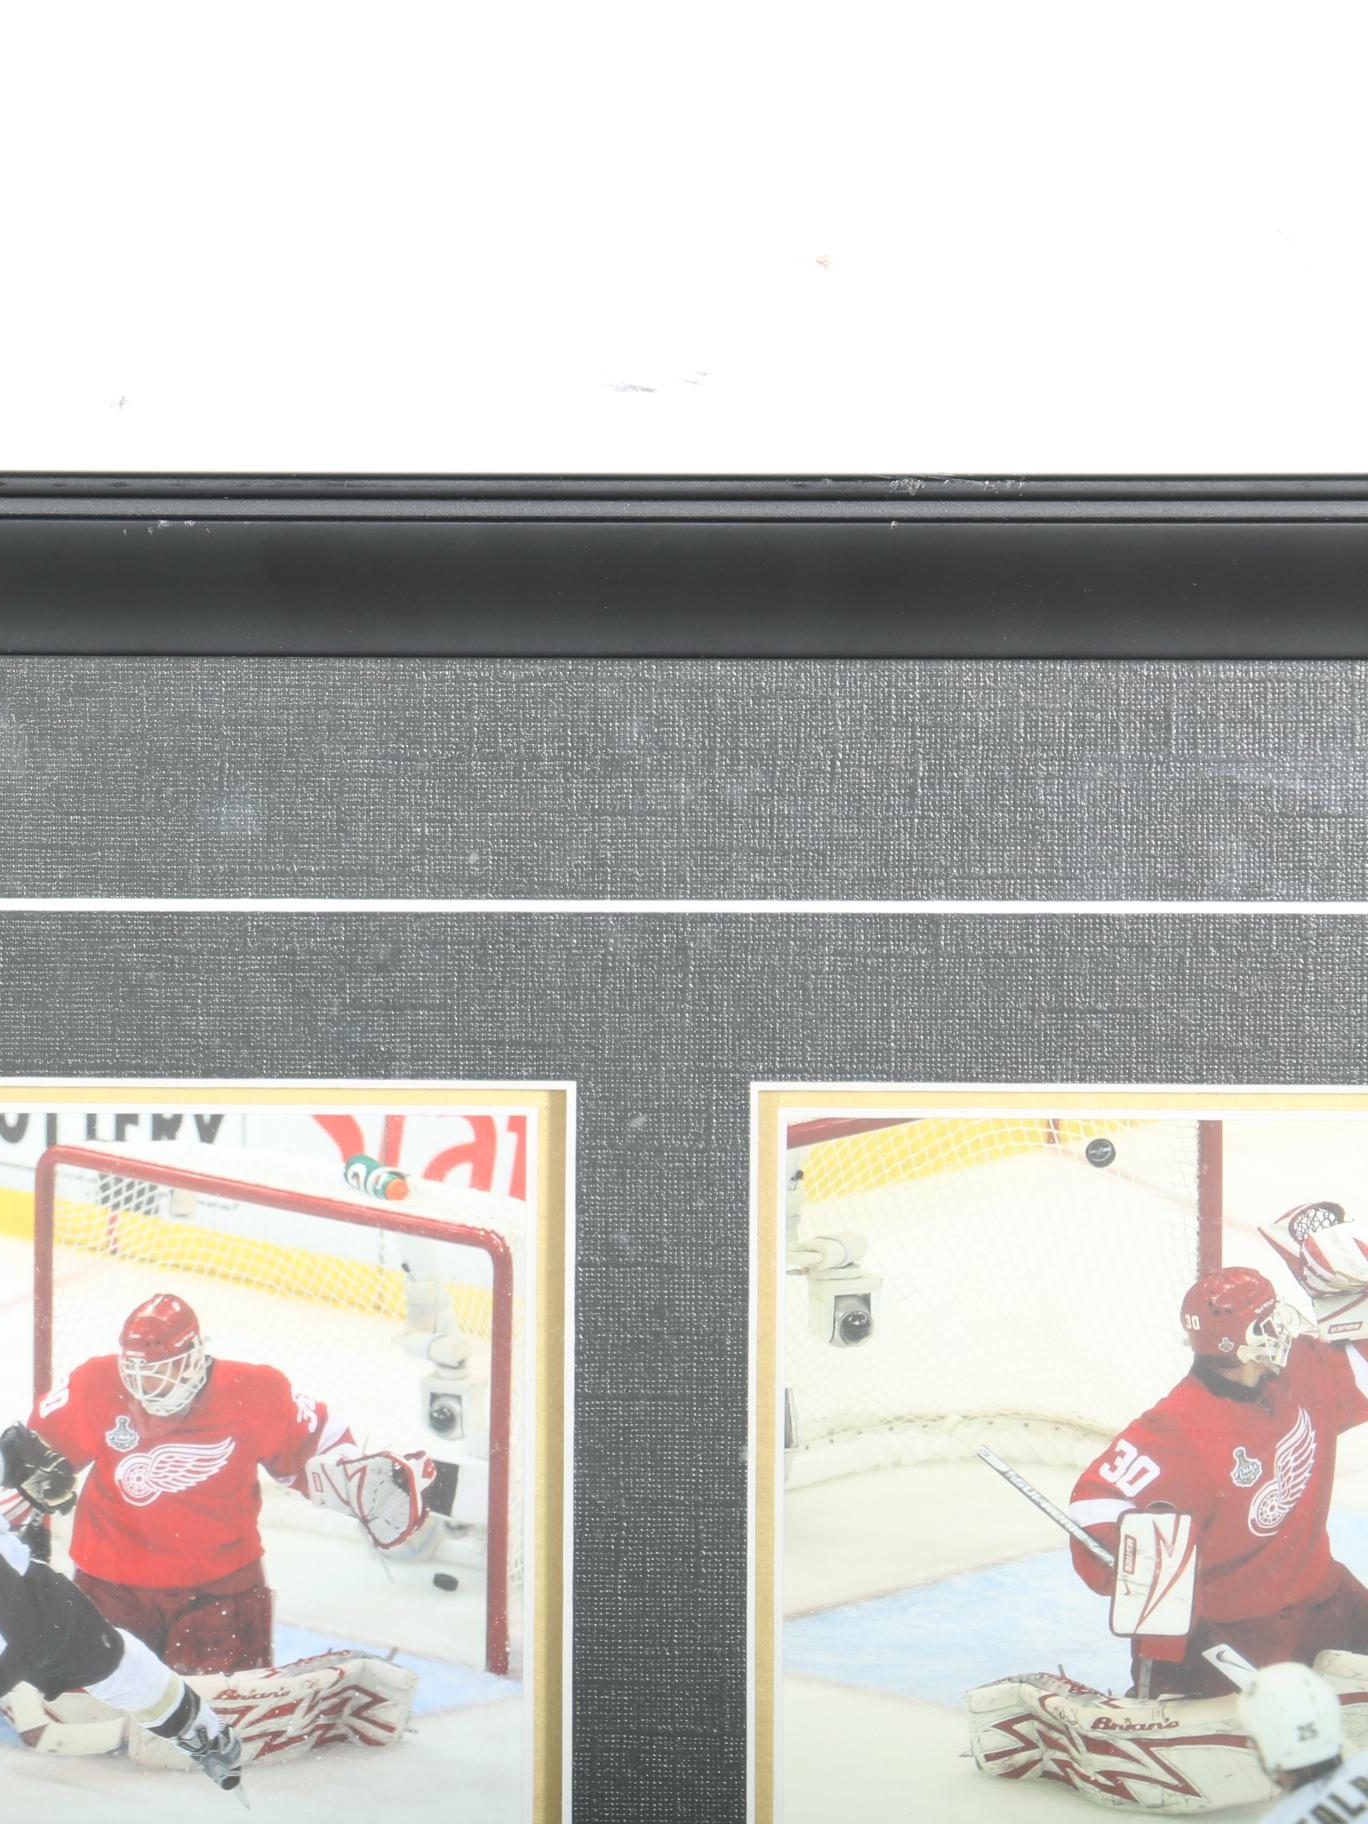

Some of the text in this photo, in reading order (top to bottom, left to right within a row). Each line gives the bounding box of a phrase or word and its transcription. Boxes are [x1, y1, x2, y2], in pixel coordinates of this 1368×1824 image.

[1182, 1313, 1201, 1331] 30
[1098, 1438, 1161, 1498] 30
[1090, 1716, 1180, 1731] Brian's
